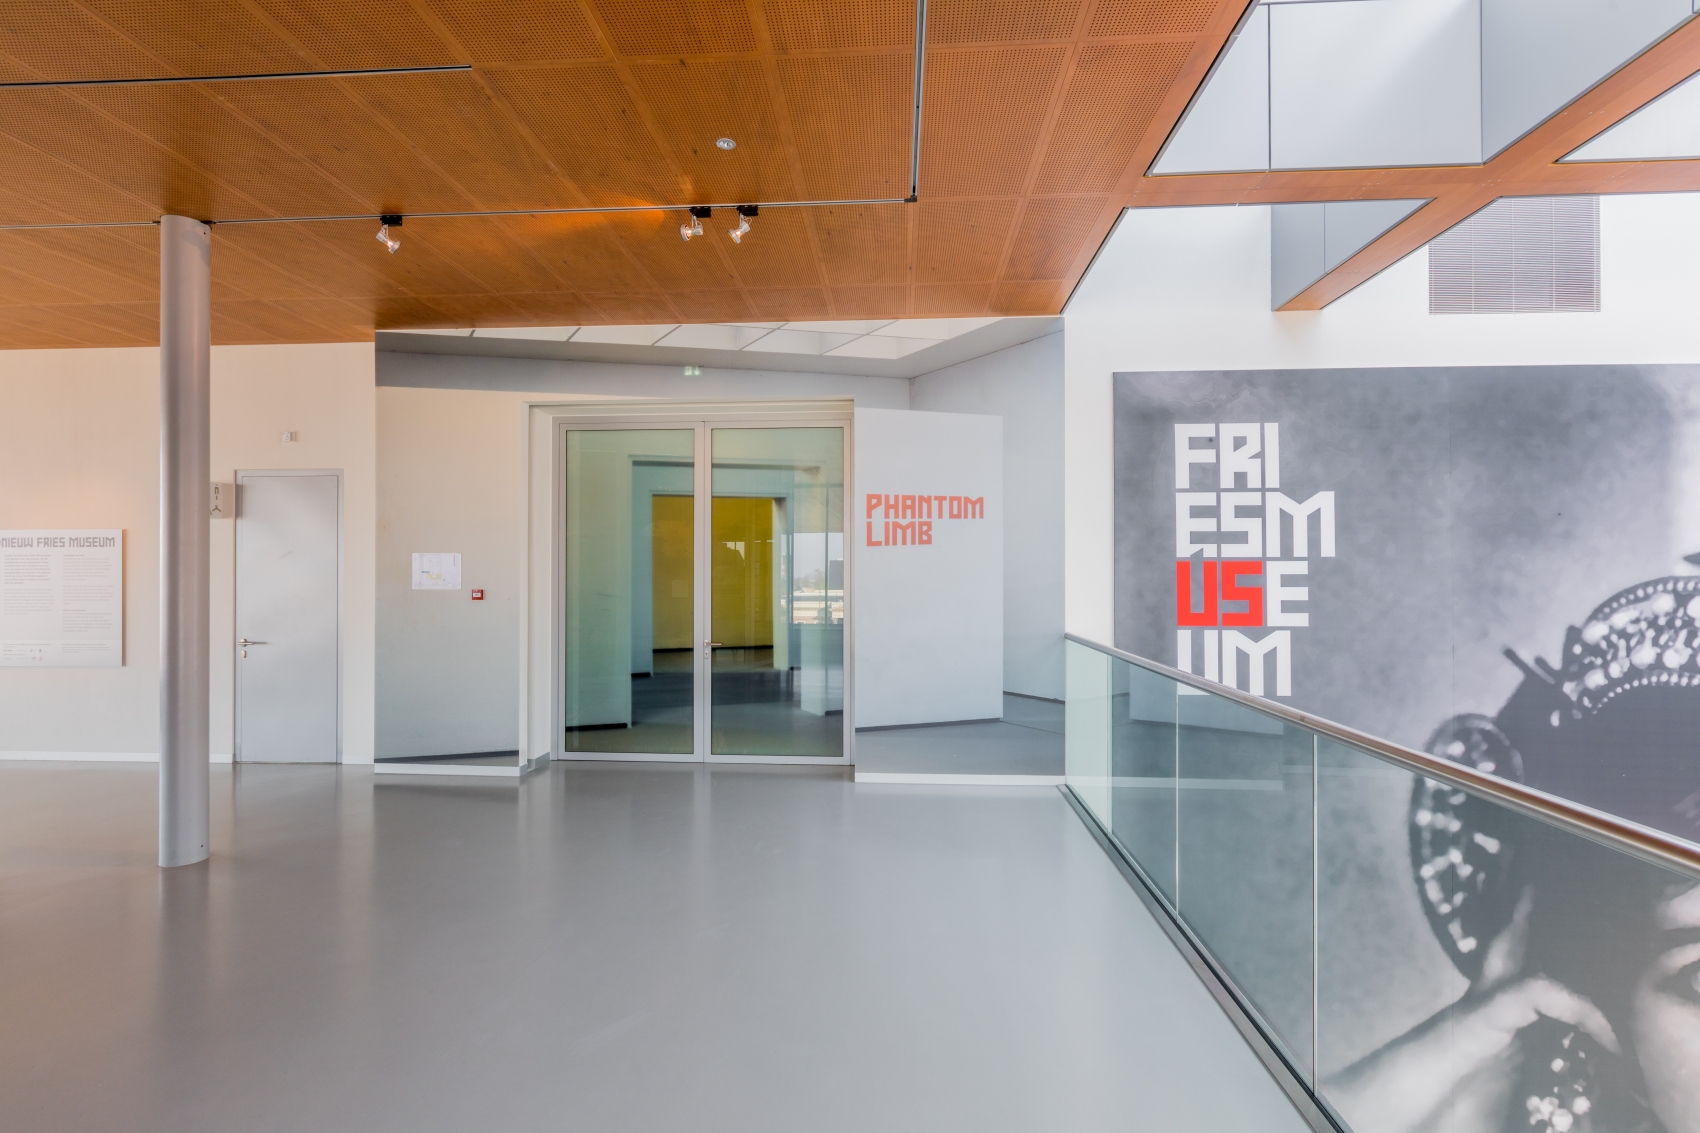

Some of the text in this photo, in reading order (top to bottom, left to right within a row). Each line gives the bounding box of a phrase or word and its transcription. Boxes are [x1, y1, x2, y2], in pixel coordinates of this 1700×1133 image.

[1174, 422, 1280, 489] FRI
[866, 493, 985, 520] PHANTOM
[1175, 490, 1336, 558] ESM
[1, 536, 116, 549] NIEUW FRIES MUSEUM
[866, 520, 933, 547] LIMB
[1177, 629, 1292, 697] UM
